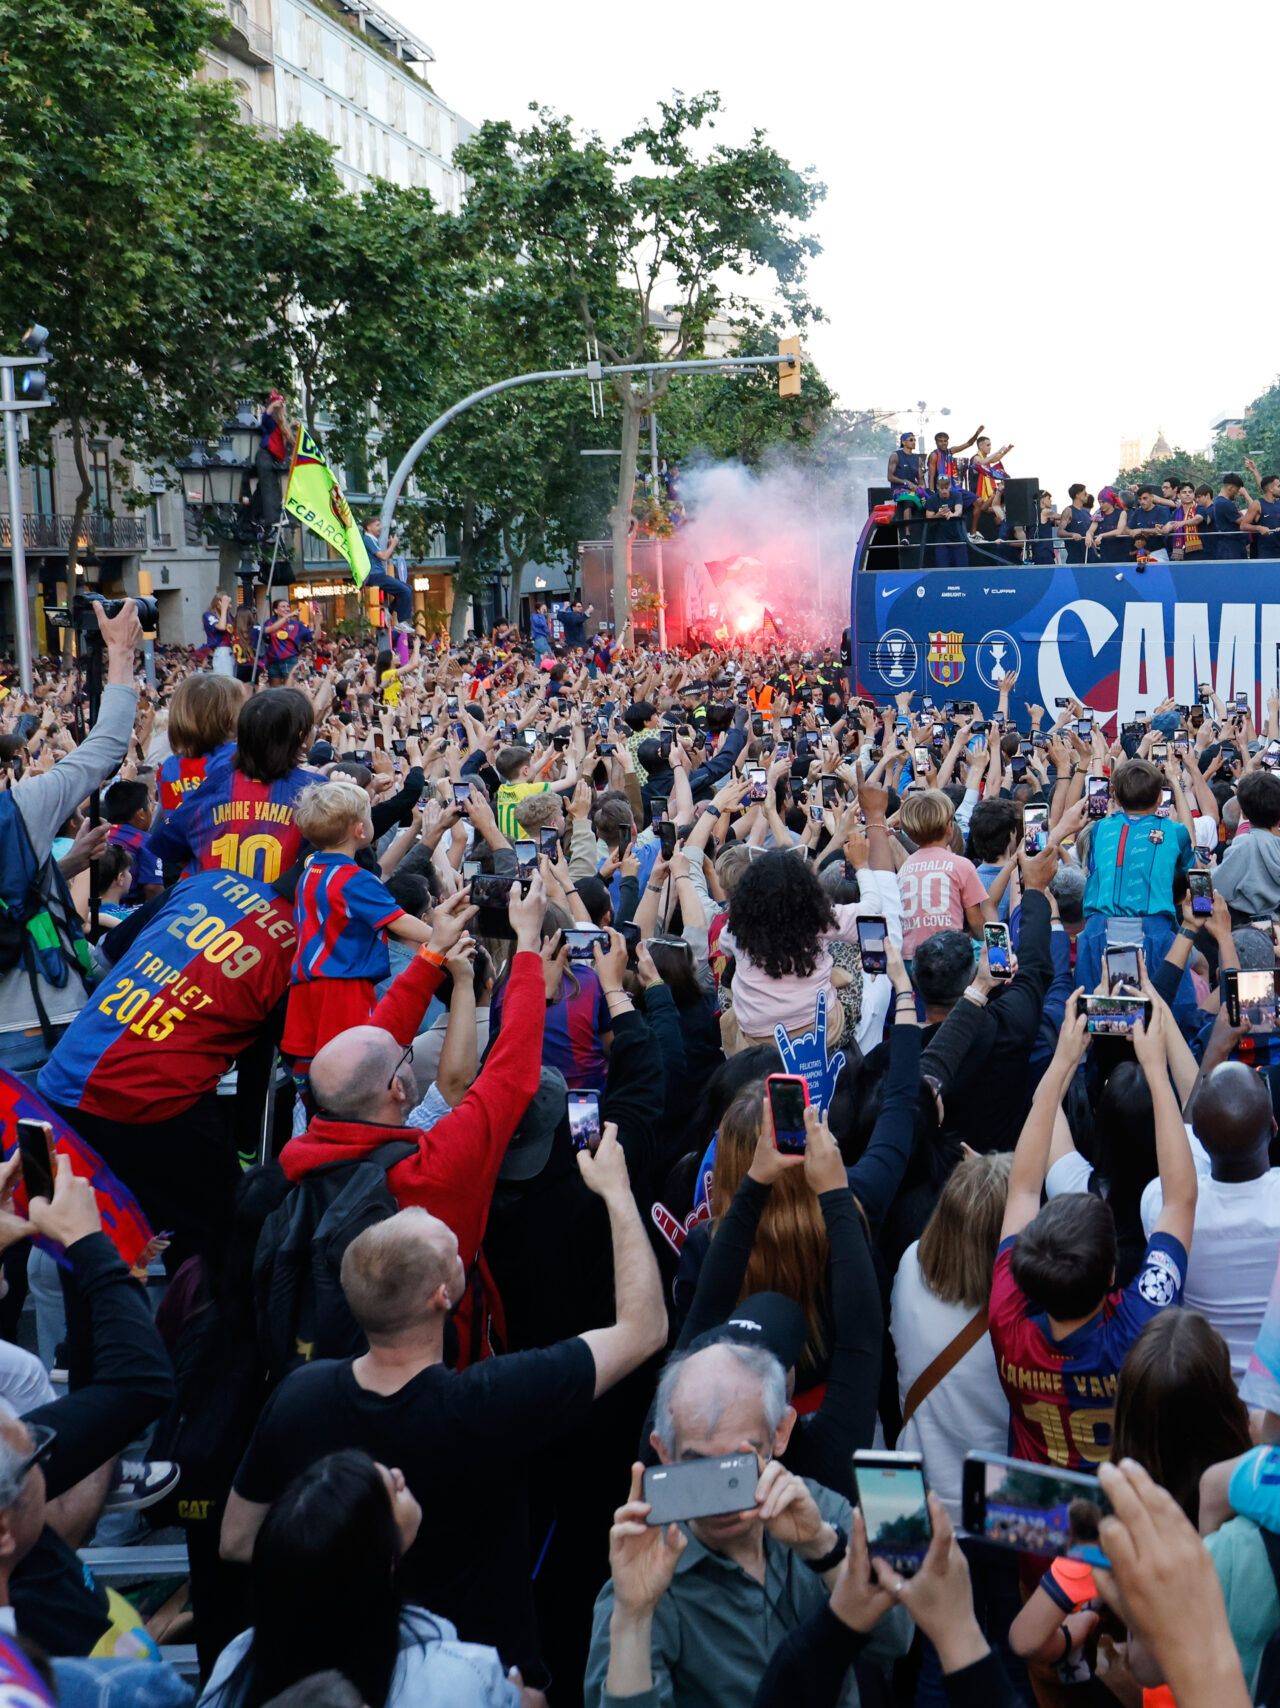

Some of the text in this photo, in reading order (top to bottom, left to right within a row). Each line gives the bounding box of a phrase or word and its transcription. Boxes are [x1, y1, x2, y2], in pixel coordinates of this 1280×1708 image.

[938, 653, 954, 661] FCB
[170, 776, 208, 796] MES
[212, 801, 294, 826] LAMINE YAMAL
[211, 833, 283, 884] 10
[212, 874, 297, 949] TRIPLET
[923, 914, 952, 927] COVE
[166, 902, 262, 979] 2009
[134, 951, 214, 1011] TRIPLET
[98, 977, 187, 1042] 2015
[1001, 1354, 1119, 1398] LAMINE YAM
[178, 1500, 209, 1520] CAT
